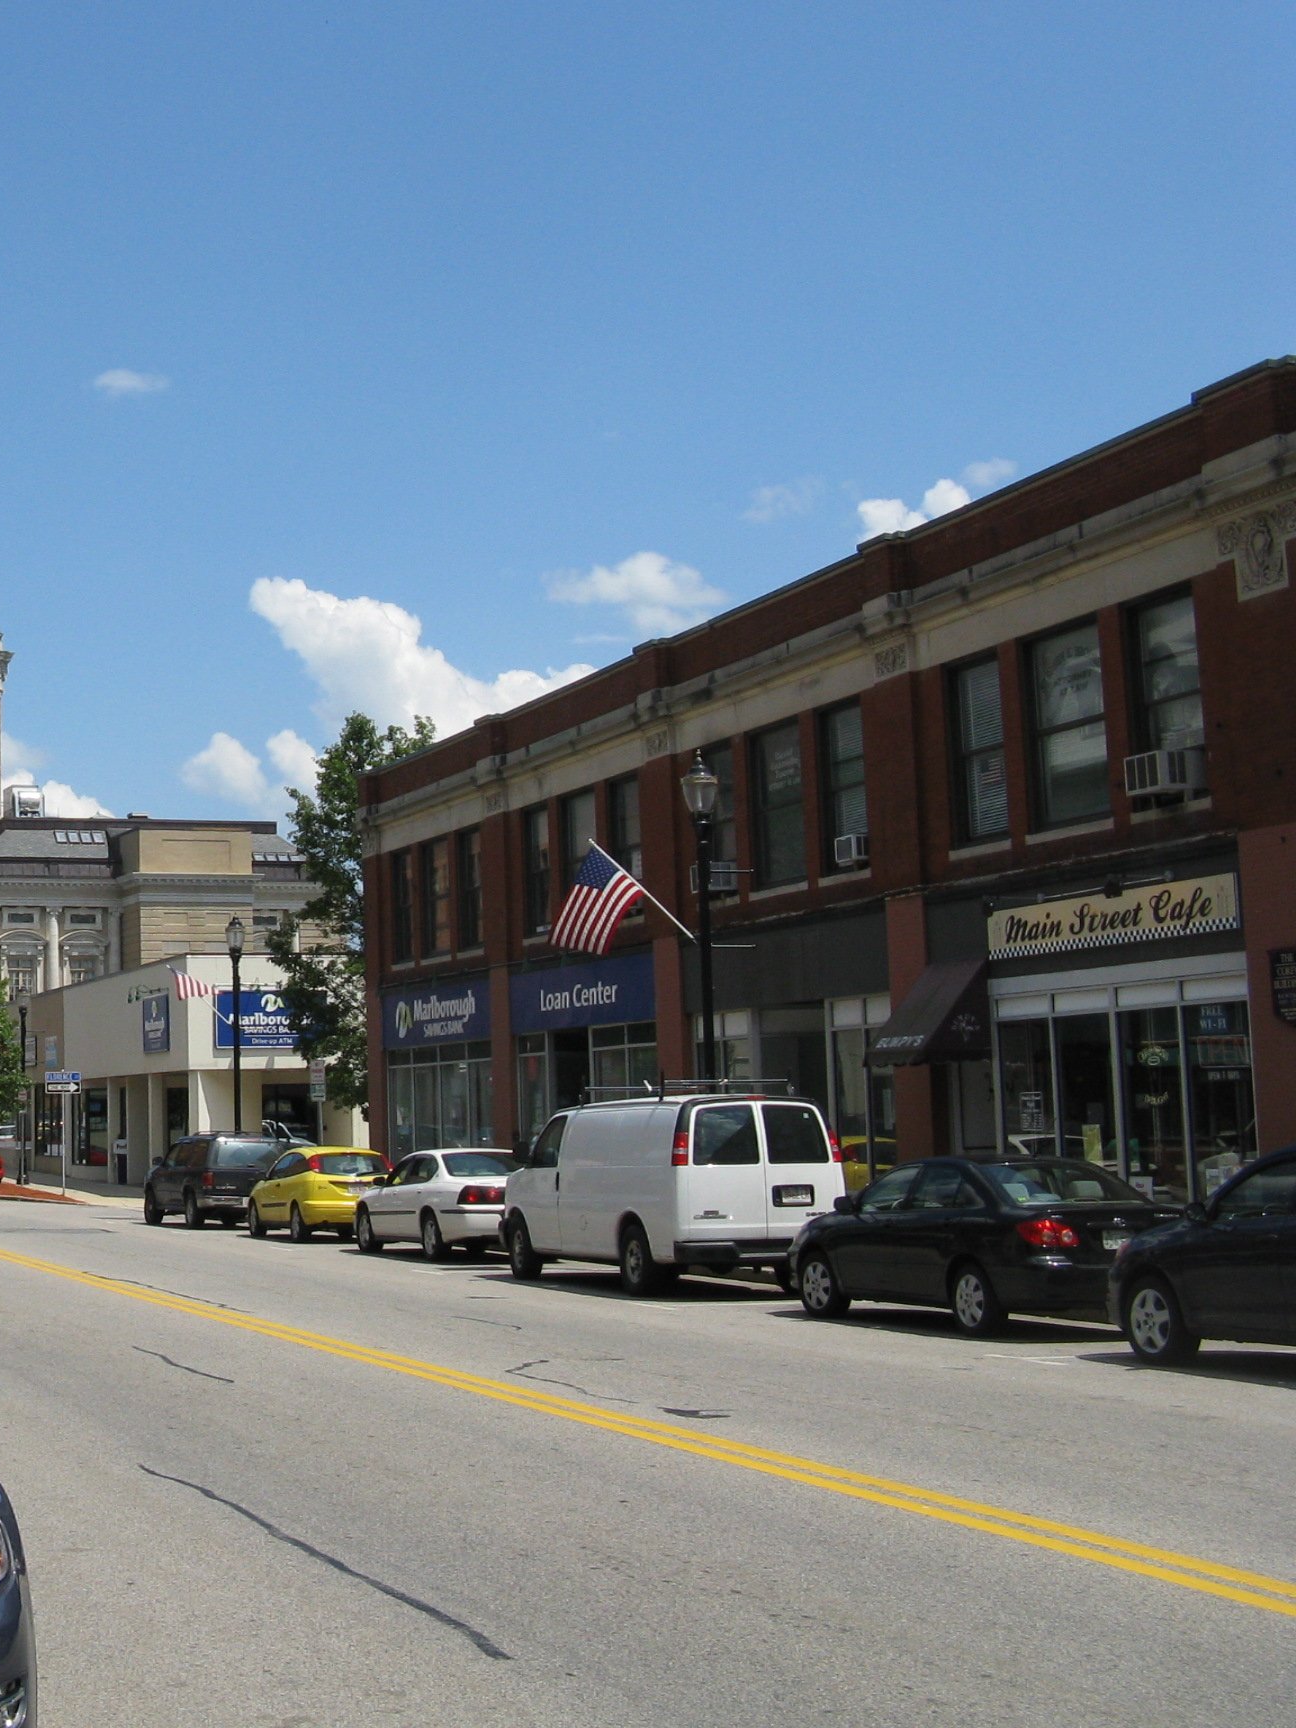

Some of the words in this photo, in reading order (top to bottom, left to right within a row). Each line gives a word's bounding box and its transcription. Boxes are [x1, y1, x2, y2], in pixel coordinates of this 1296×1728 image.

[1006, 912, 1063, 945] Main
[1068, 902, 1143, 936] Street
[1149, 886, 1213, 932] Cafe
[413, 989, 477, 1023] Marlborough
[540, 989, 570, 1012] Loan
[572, 981, 618, 1008] Center
[1201, 1006, 1223, 1016] FREE
[227, 1011, 314, 1027] Marlboro
